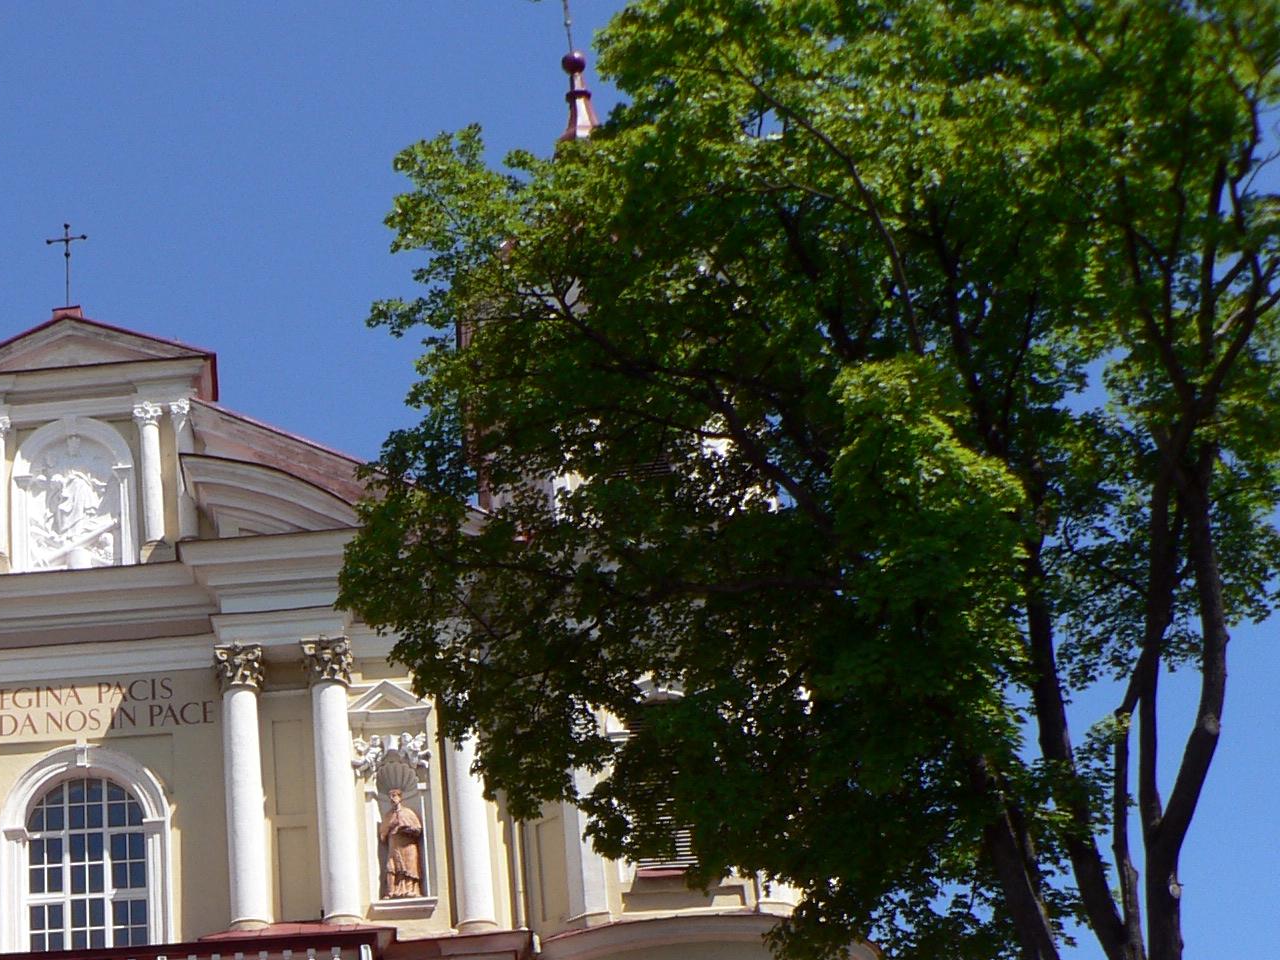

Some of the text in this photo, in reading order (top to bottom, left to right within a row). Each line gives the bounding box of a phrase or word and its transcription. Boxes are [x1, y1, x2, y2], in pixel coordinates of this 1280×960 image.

[97, 677, 174, 705] PACIS
[45, 708, 102, 735] NOS
[110, 705, 137, 730] IN
[148, 700, 216, 727] PACE
